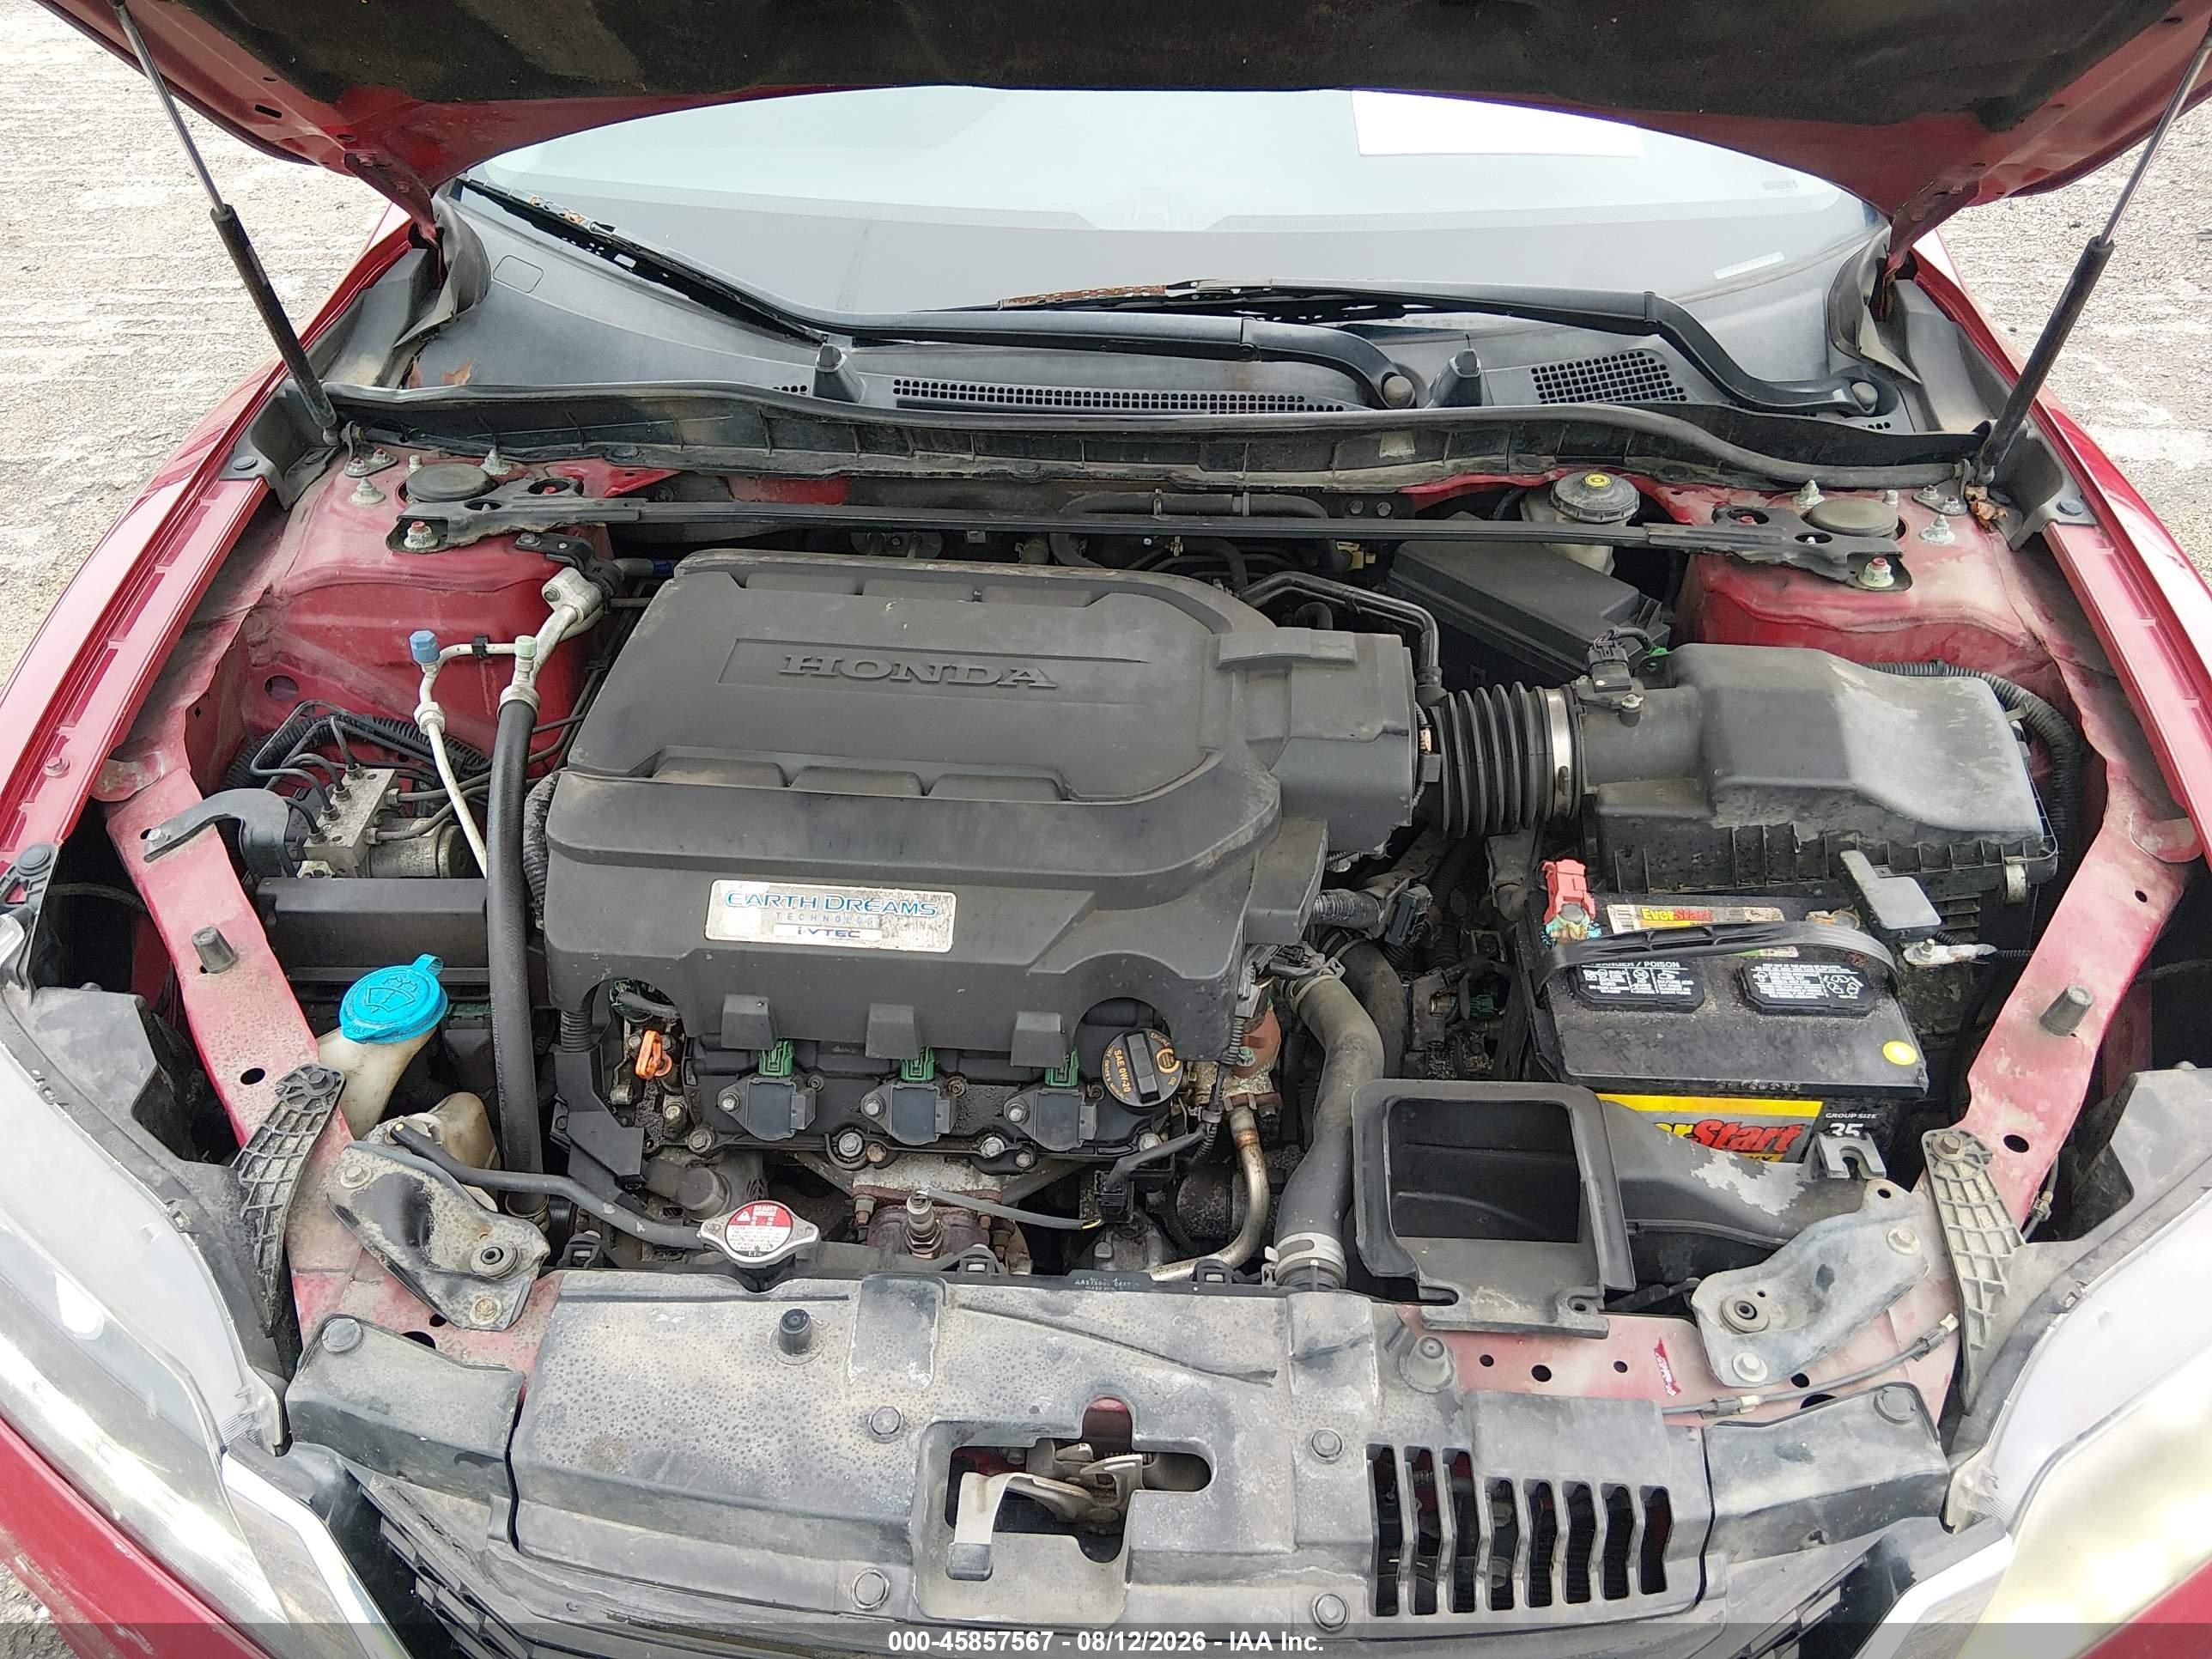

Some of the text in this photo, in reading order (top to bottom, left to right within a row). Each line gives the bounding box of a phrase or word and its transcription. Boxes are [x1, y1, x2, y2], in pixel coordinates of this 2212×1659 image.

[779, 656, 1058, 688] HONDA
[726, 891, 939, 917] EARTH DREAMS
[775, 913, 876, 926] TECHNOLOG
[1641, 908, 1712, 921] EverStart
[1114, 1049, 1131, 1092] SAE 0W-20
[1830, 1122, 1863, 1137] 35
